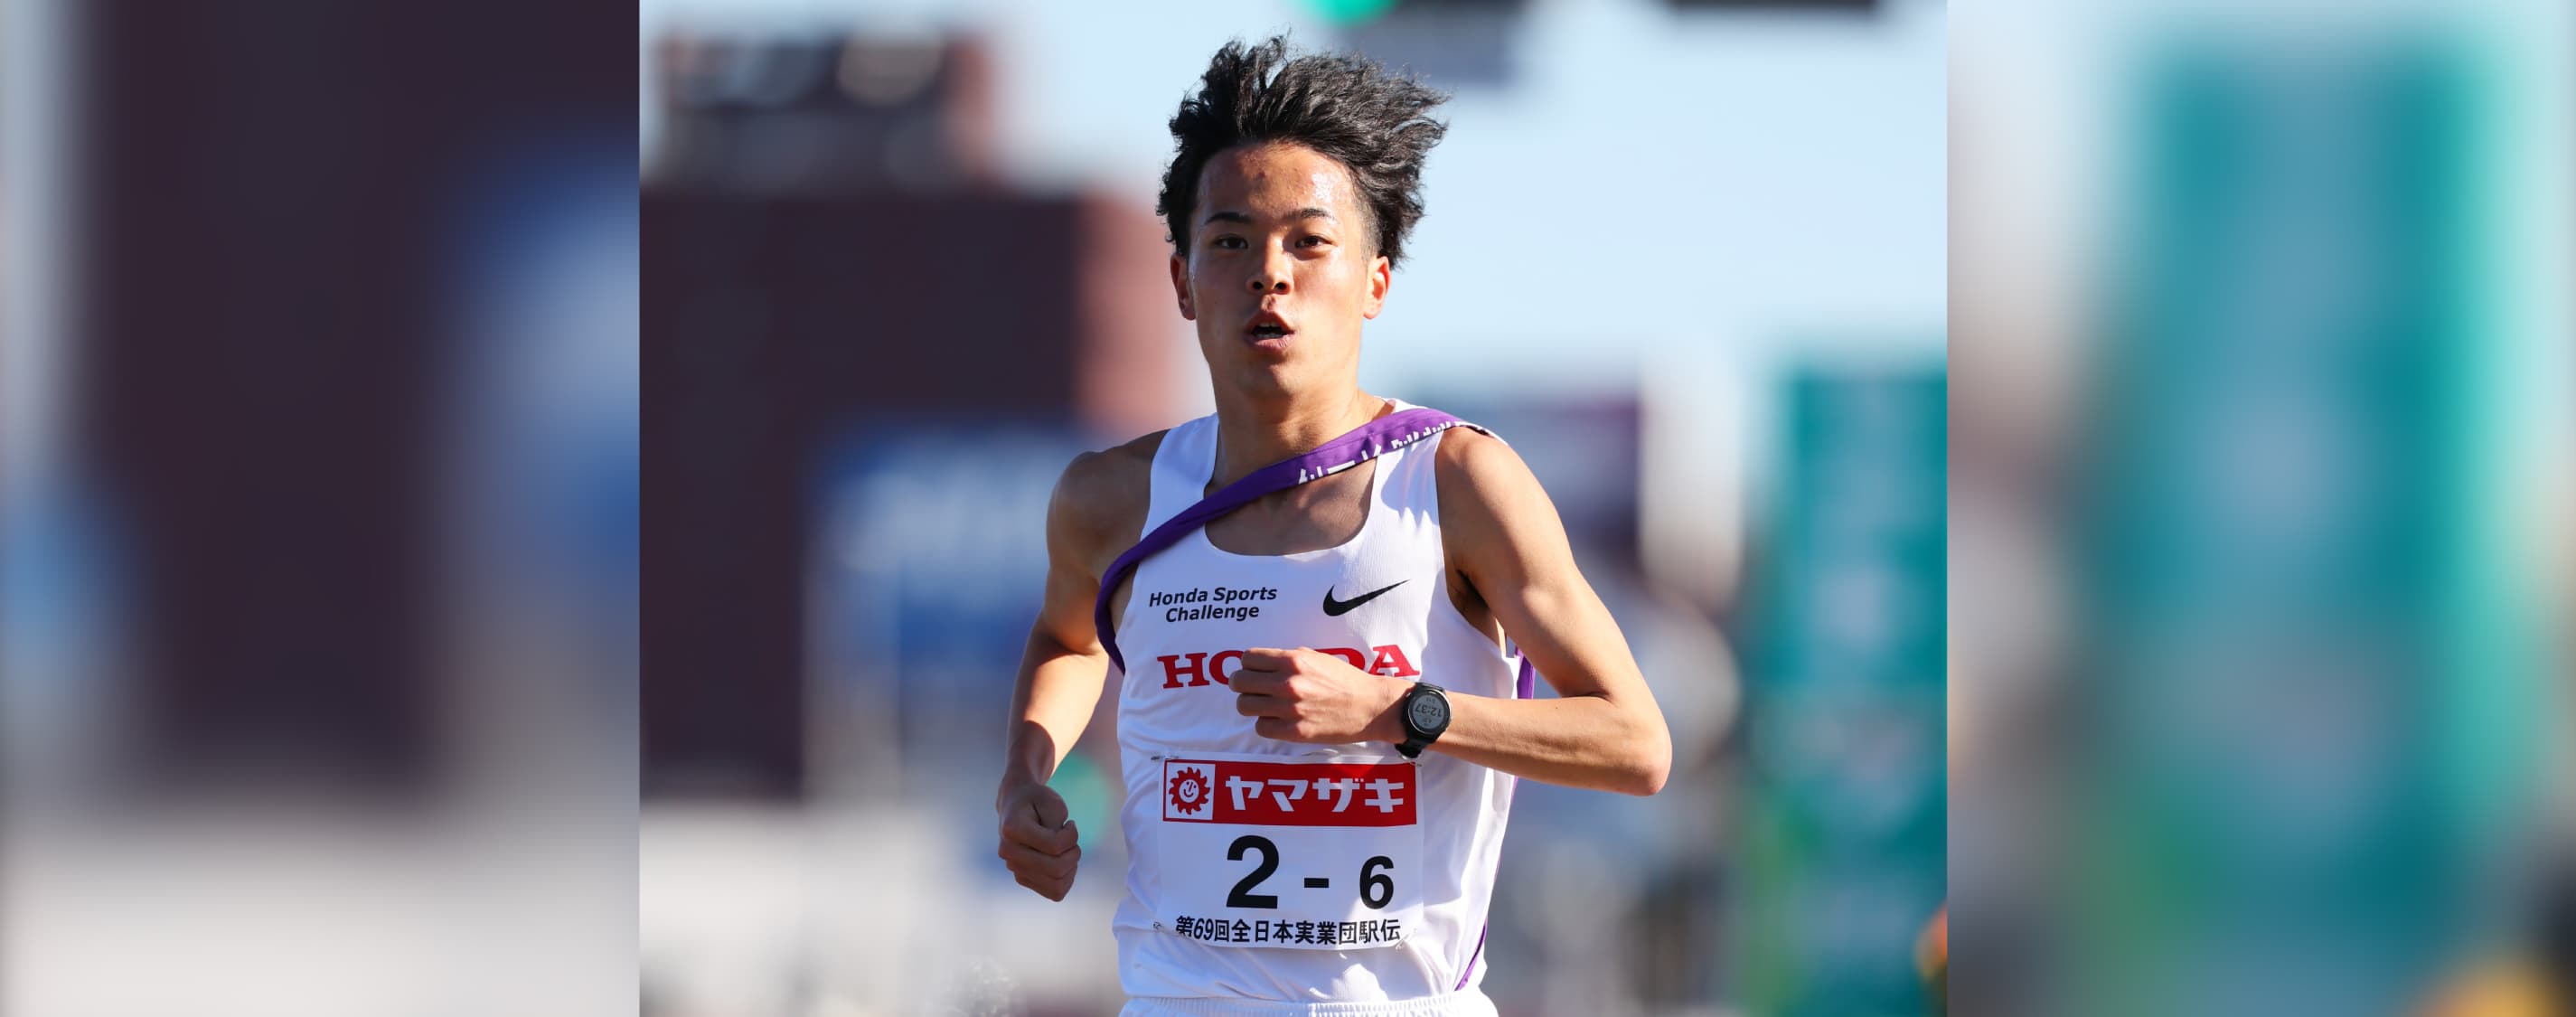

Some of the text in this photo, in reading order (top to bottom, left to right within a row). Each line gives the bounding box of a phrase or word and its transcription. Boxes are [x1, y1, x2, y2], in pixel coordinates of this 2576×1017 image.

[1149, 587, 1278, 607] Honda Sports
[1165, 605, 1260, 623] Challenge
[1225, 775, 1404, 813] ヤマザキ
[1175, 915, 1401, 946] 第69回全日本実業団駅伝
